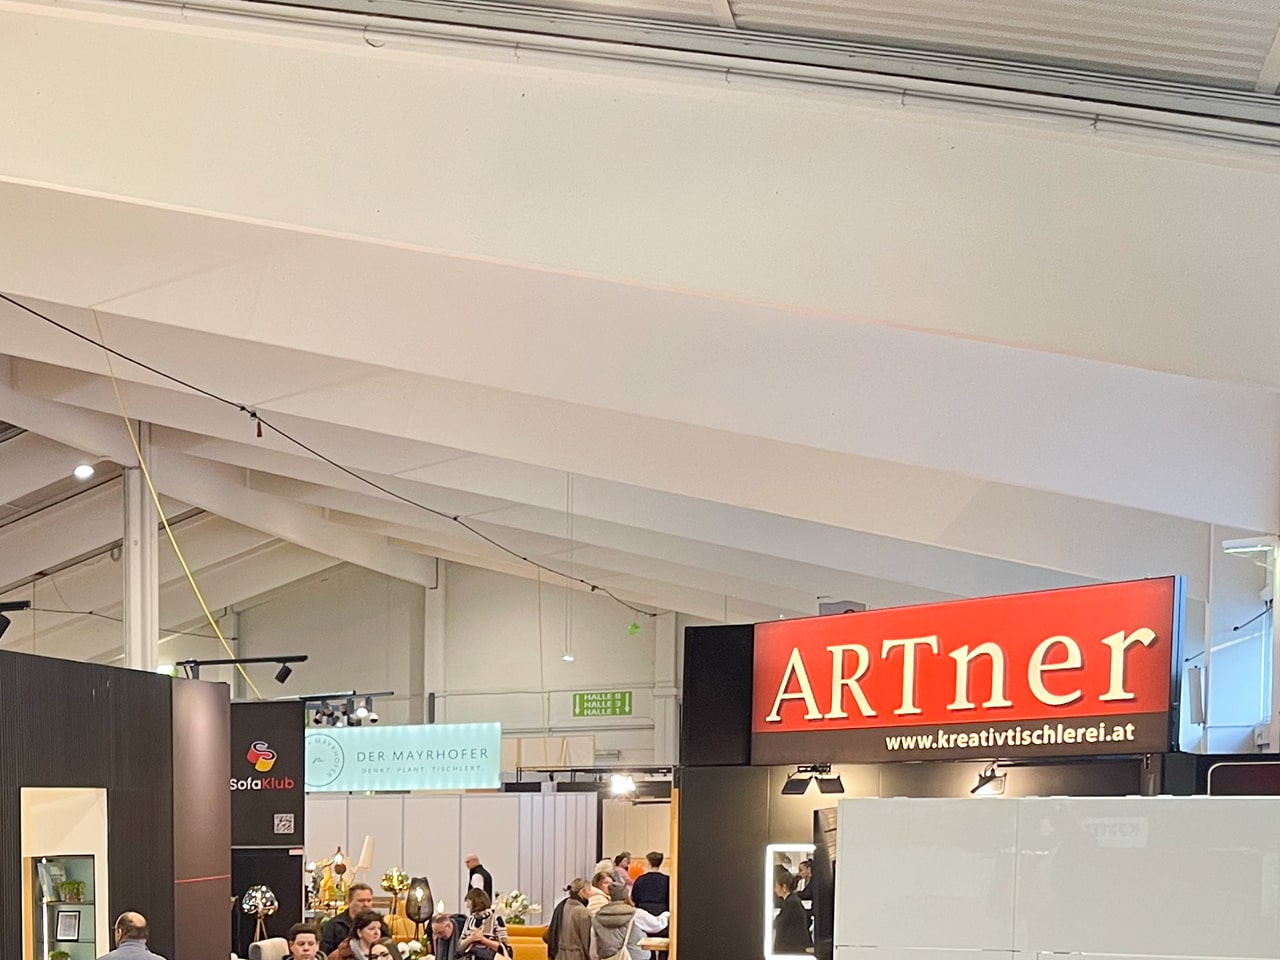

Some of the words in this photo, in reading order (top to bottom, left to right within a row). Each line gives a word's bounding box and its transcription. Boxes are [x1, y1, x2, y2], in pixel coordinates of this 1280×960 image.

[765, 626, 1157, 724] ARTner
[584, 700, 612, 708] HALLE
[885, 722, 1135, 751] www.kreativtischlerei.at
[356, 751, 385, 762] DER
[392, 748, 488, 761] MAYRHOFER
[229, 777, 295, 790] SofaKlub
